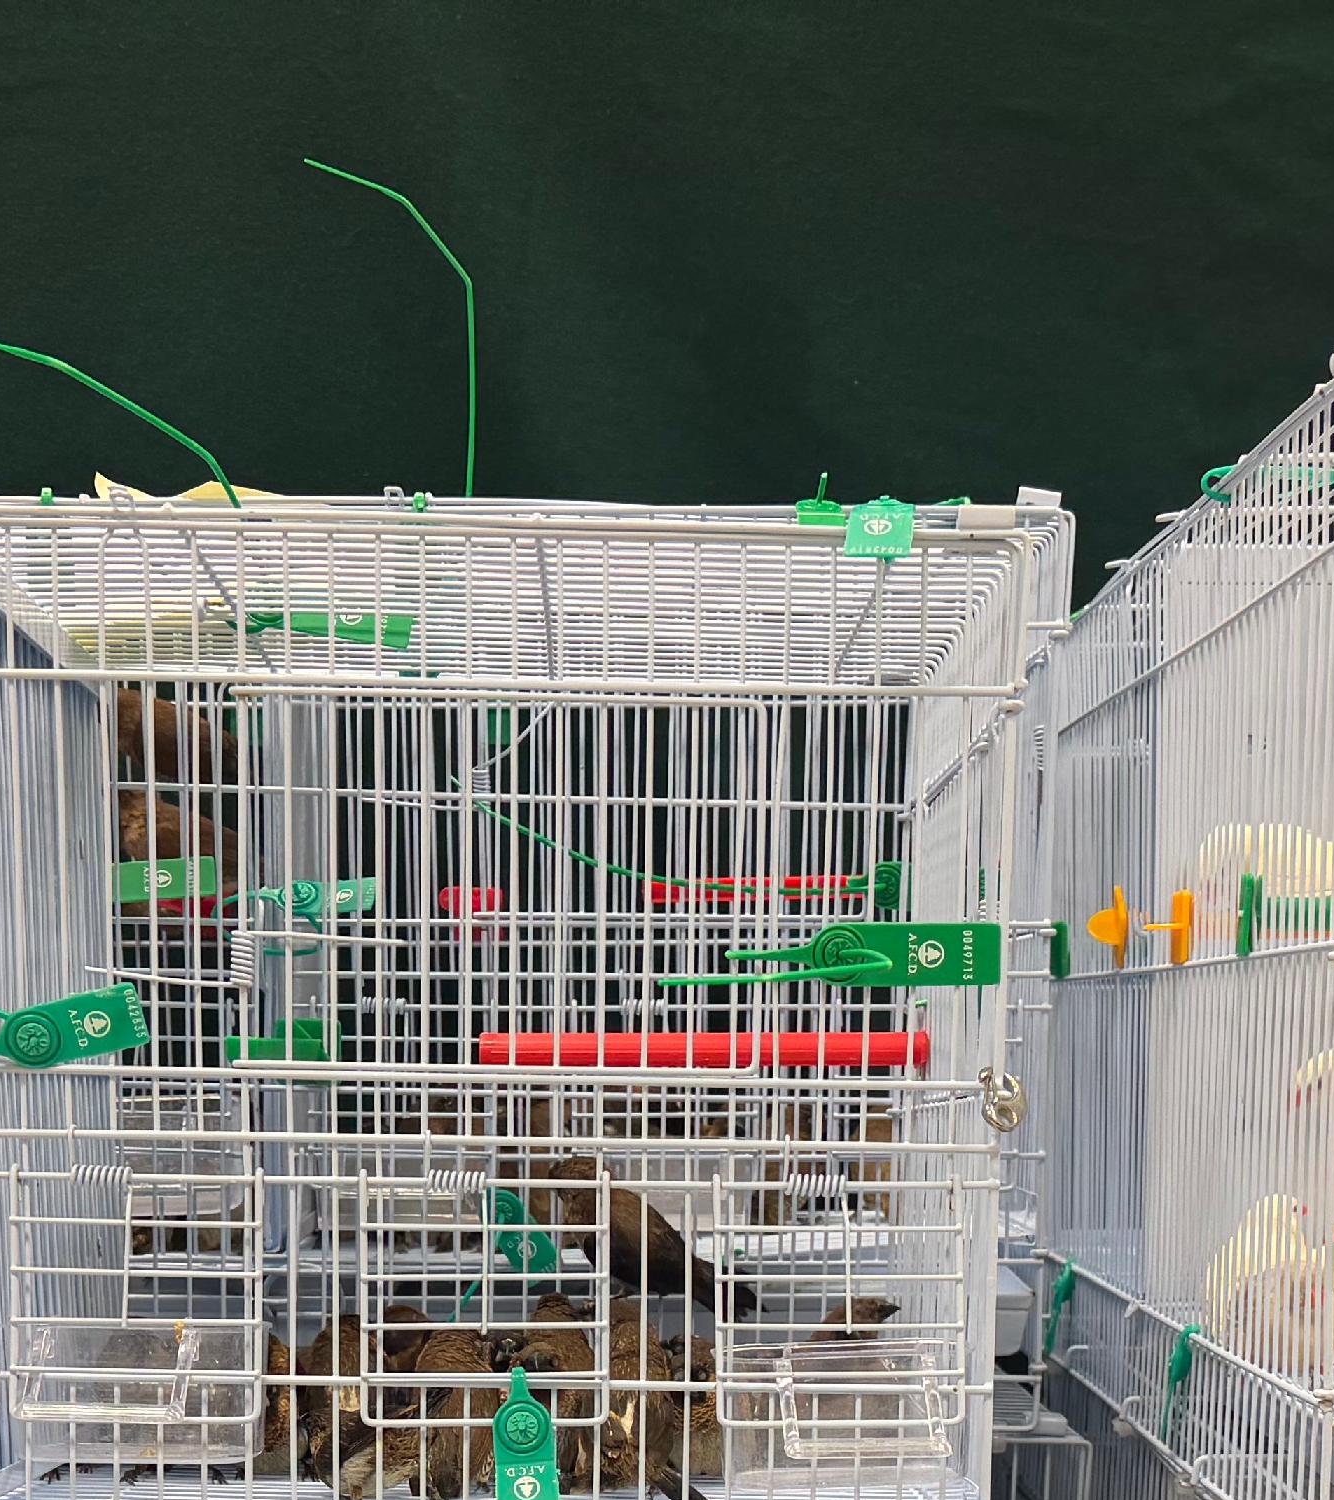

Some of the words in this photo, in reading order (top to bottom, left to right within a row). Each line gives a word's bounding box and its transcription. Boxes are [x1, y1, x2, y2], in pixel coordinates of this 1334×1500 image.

[908, 932, 918, 976] A.F.C.D.
[68, 1009, 89, 1047] A.F.C.D.
[505, 1465, 545, 1476] A.F.C.D.
